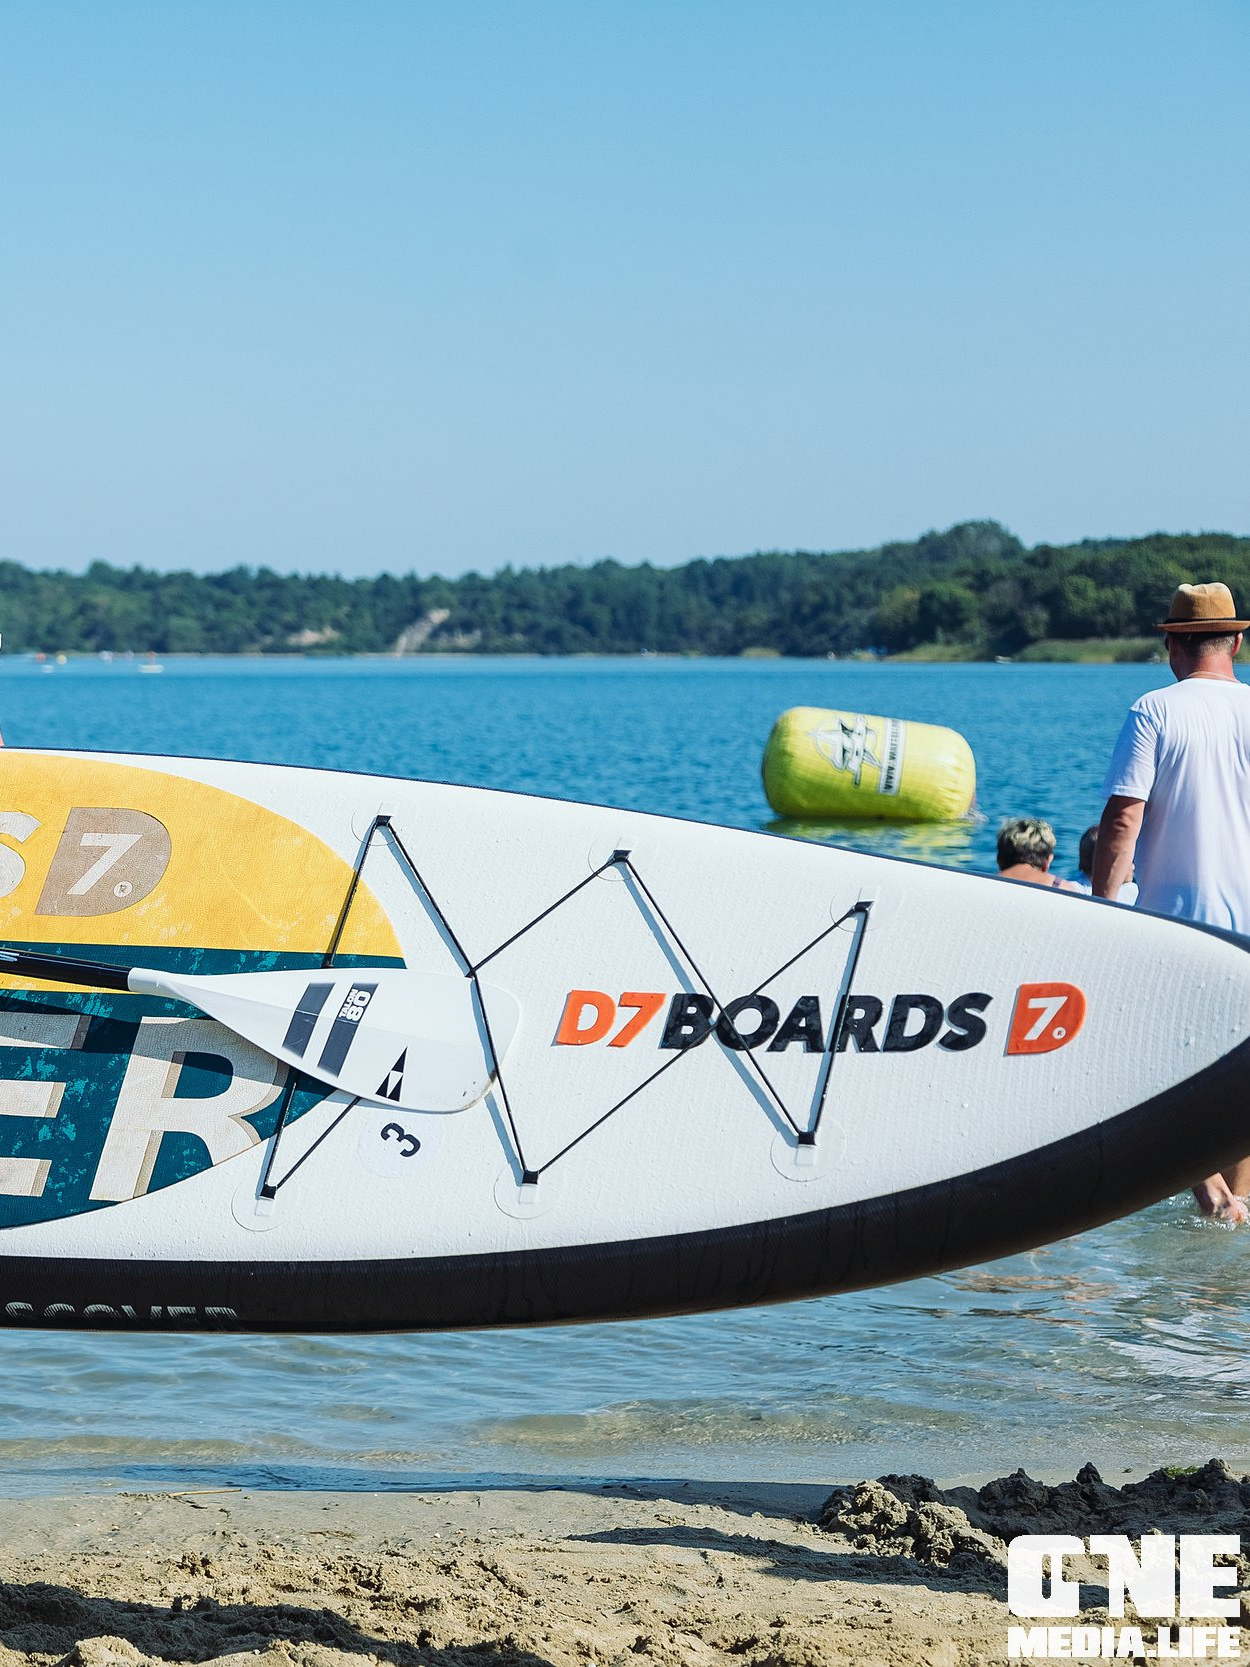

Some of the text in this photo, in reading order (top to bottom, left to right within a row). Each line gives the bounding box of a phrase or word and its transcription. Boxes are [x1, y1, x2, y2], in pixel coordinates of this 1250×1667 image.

[338, 988, 358, 1019] TALON
[347, 990, 372, 1022] 80
[554, 989, 993, 1053] D7BOARDS
[381, 1122, 421, 1158] 3
